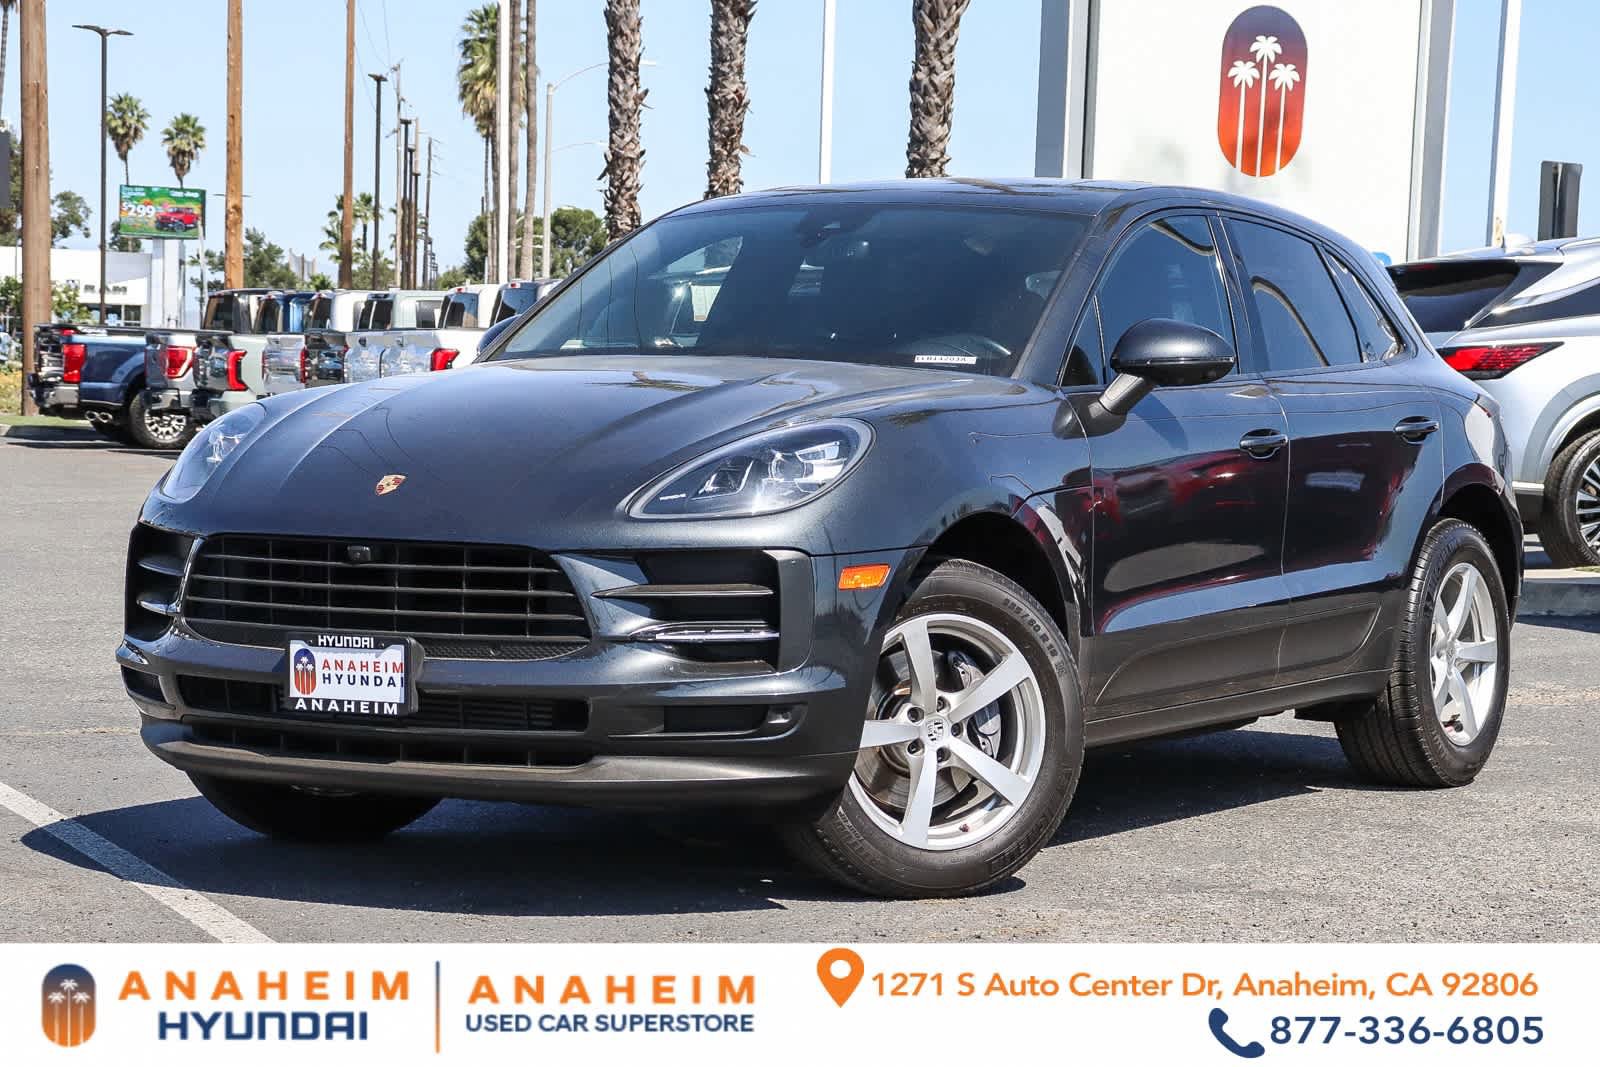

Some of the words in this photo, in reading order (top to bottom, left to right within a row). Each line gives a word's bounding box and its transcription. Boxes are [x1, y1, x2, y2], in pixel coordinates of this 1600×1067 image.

[121, 201, 156, 217] $299
[318, 635, 374, 648] HYUNDAI
[322, 659, 404, 673] ANAHEIM
[322, 673, 404, 688] HYUNDAI
[295, 698, 398, 715] ANAHEIM
